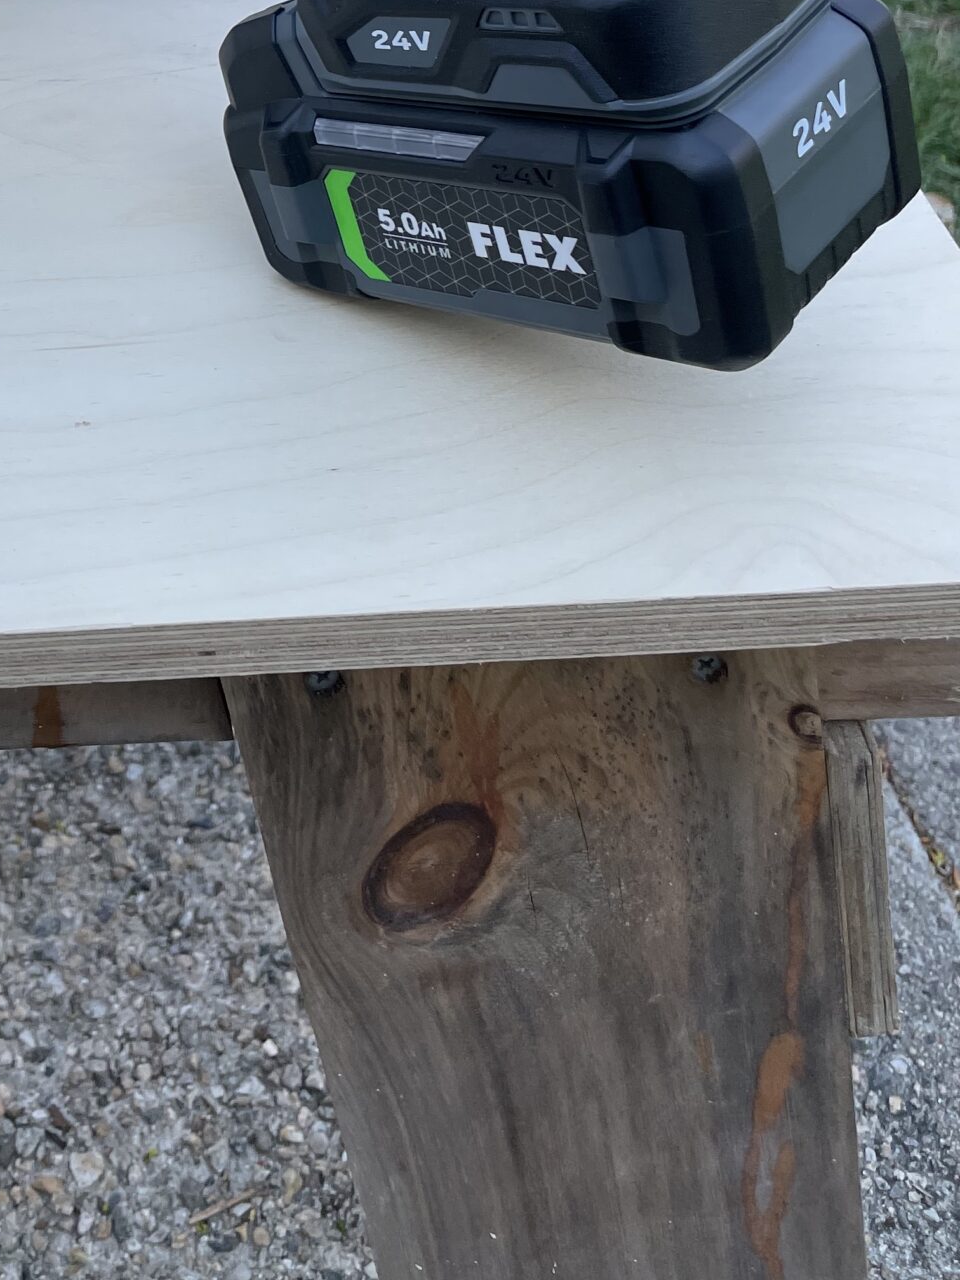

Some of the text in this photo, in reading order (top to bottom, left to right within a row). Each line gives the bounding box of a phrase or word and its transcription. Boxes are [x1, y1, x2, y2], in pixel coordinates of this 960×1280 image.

[371, 30, 431, 51] 24V
[792, 78, 847, 158] 24V
[492, 164, 554, 188] 24V
[377, 208, 447, 241] 5.0Ah
[385, 238, 451, 259] LITHIUM
[466, 221, 587, 275] FLEX
